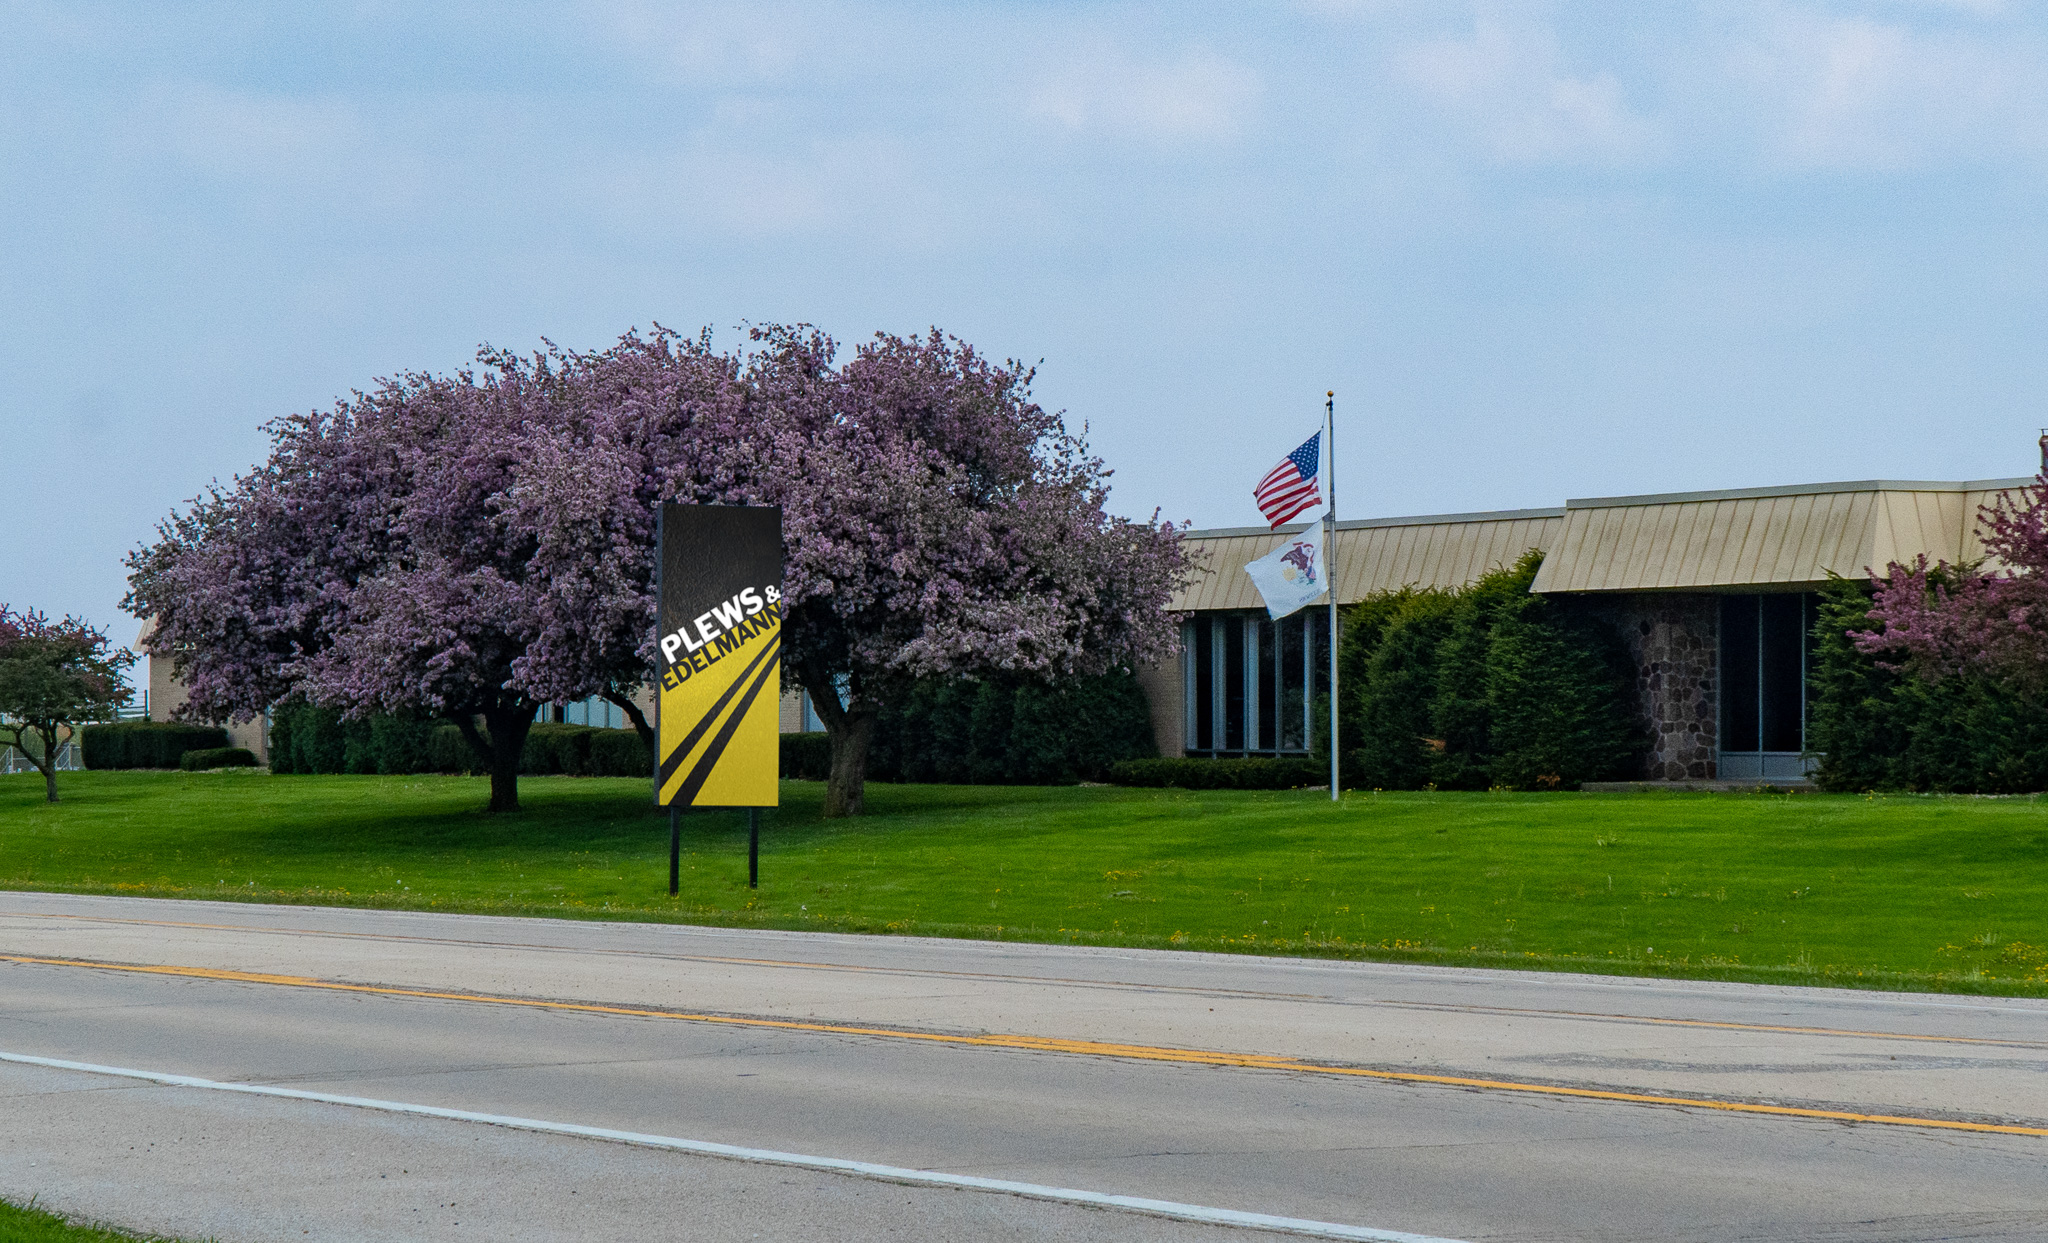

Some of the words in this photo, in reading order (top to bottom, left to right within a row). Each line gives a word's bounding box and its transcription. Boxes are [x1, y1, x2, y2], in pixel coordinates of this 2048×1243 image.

[660, 587, 764, 665] PLEWS
[764, 585, 781, 604] &
[660, 601, 781, 692] EDELMANN
